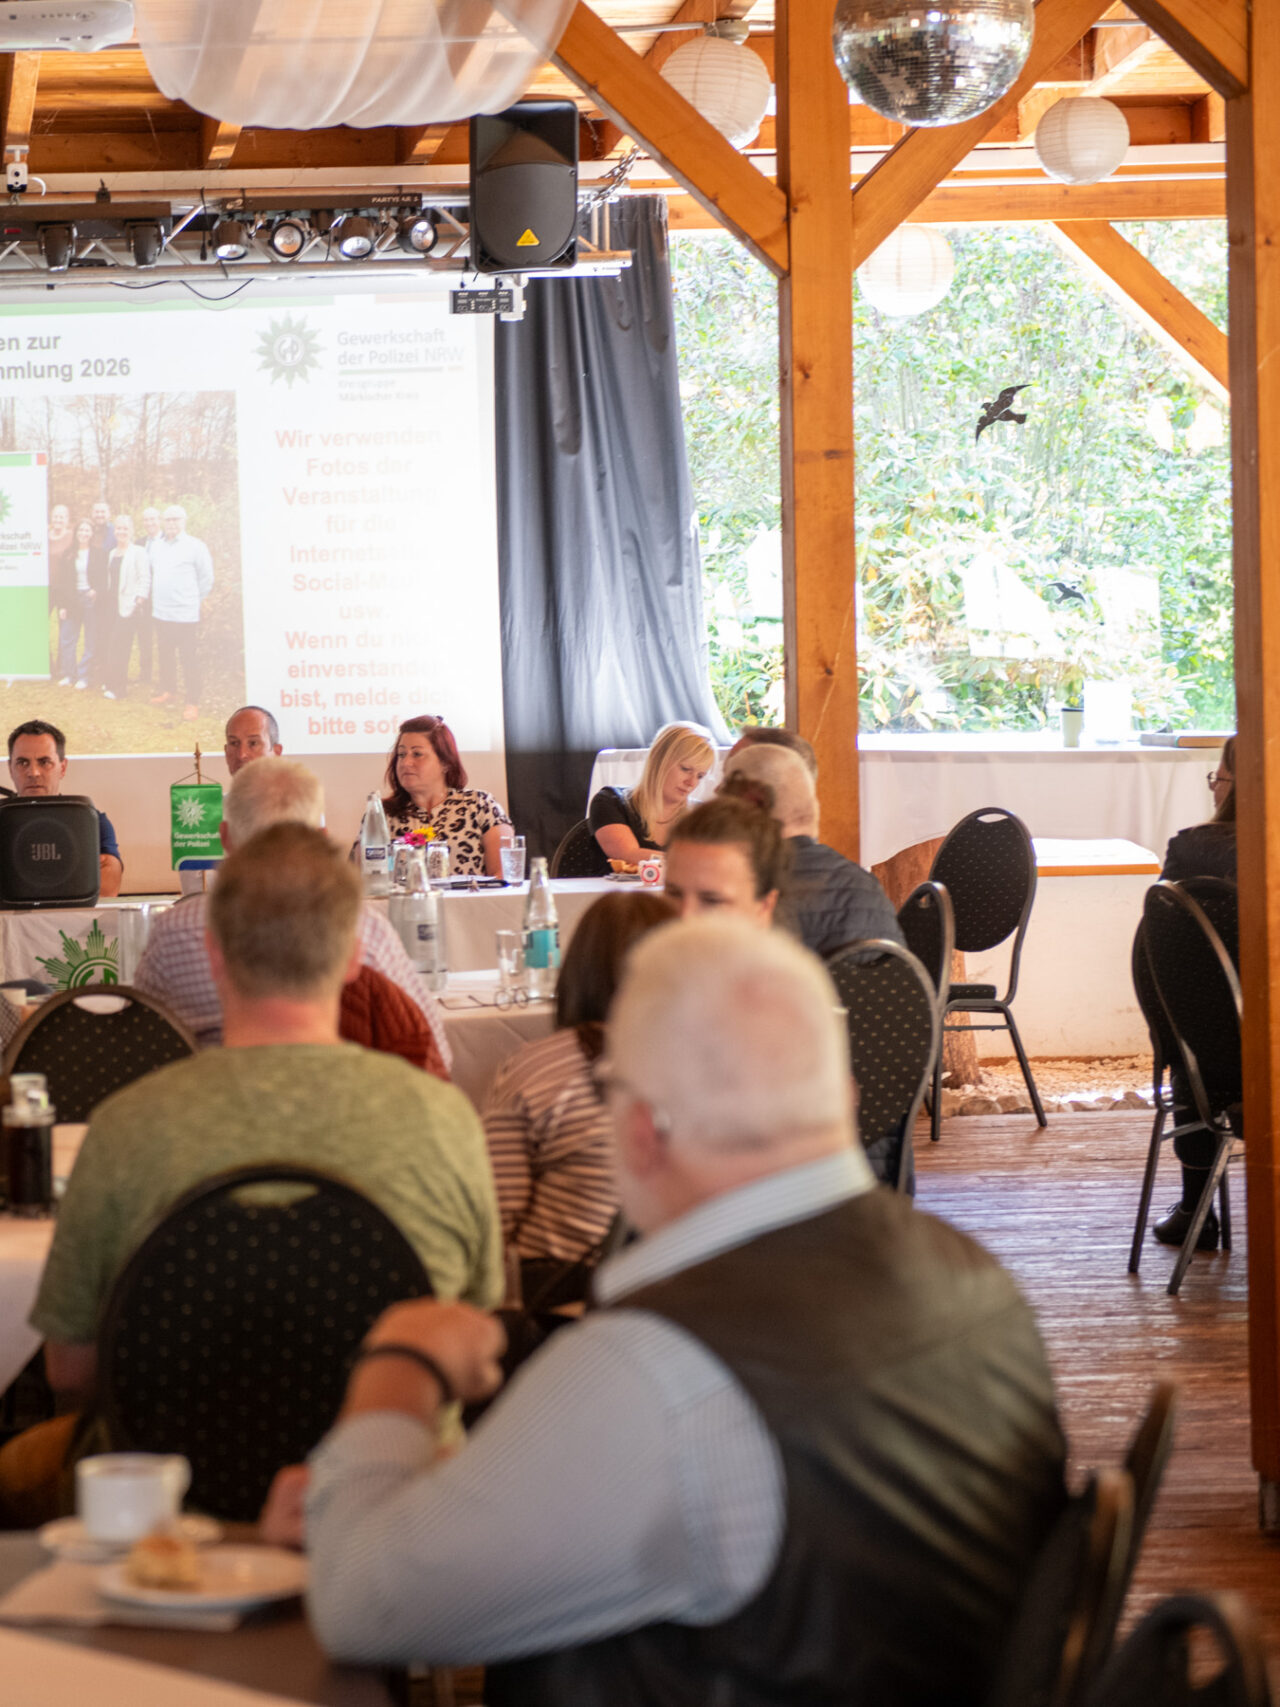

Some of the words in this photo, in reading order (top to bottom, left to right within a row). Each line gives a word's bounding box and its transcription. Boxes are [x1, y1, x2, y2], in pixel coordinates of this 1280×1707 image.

[26, 335, 61, 351] zur
[338, 328, 445, 345] Gewerkschaft
[338, 350, 364, 366] der
[369, 348, 419, 365] Polizei
[80, 358, 131, 378] 2026
[275, 429, 313, 449] Wir
[306, 457, 369, 477] Fotos
[325, 514, 356, 534] für
[284, 630, 348, 650] Wenn
[355, 628, 384, 648] du
[280, 688, 328, 710] bist,
[334, 686, 401, 707] melde
[307, 715, 357, 735] bitte
[31, 843, 61, 861] JBL
